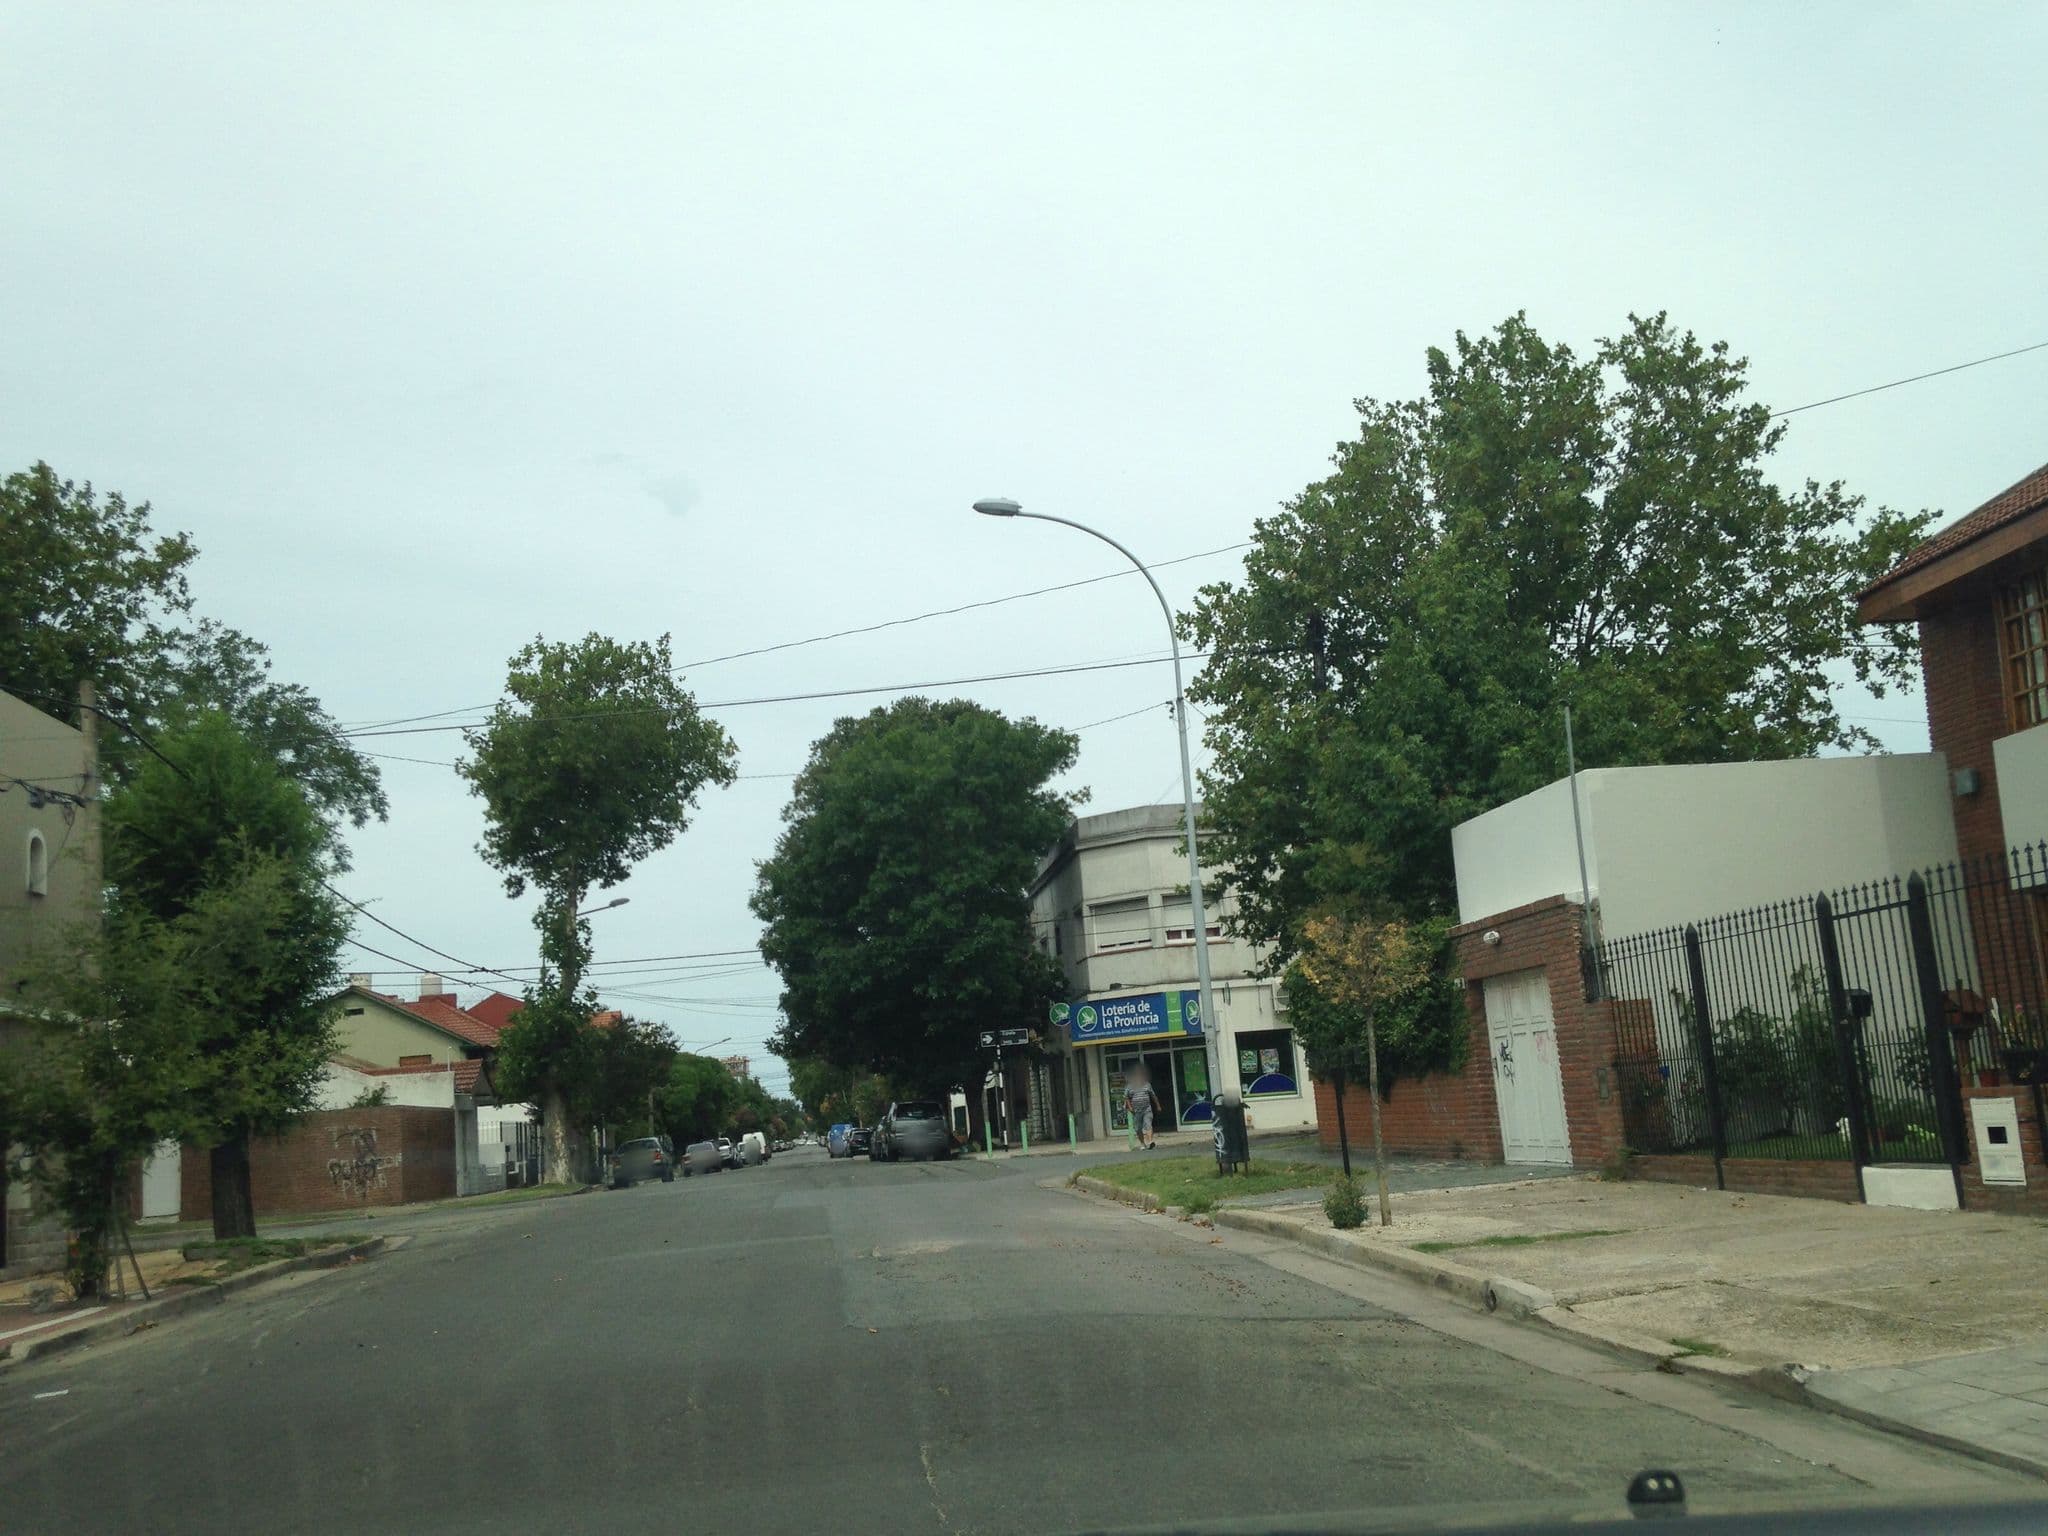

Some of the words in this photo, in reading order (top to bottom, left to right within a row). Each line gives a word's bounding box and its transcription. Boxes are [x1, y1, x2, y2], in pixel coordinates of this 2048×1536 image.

[1101, 1002, 1136, 1017] Lotería
[1138, 1000, 1151, 1012] de
[1103, 1017, 1113, 1029] la
[1114, 1012, 1159, 1028] Provincia
